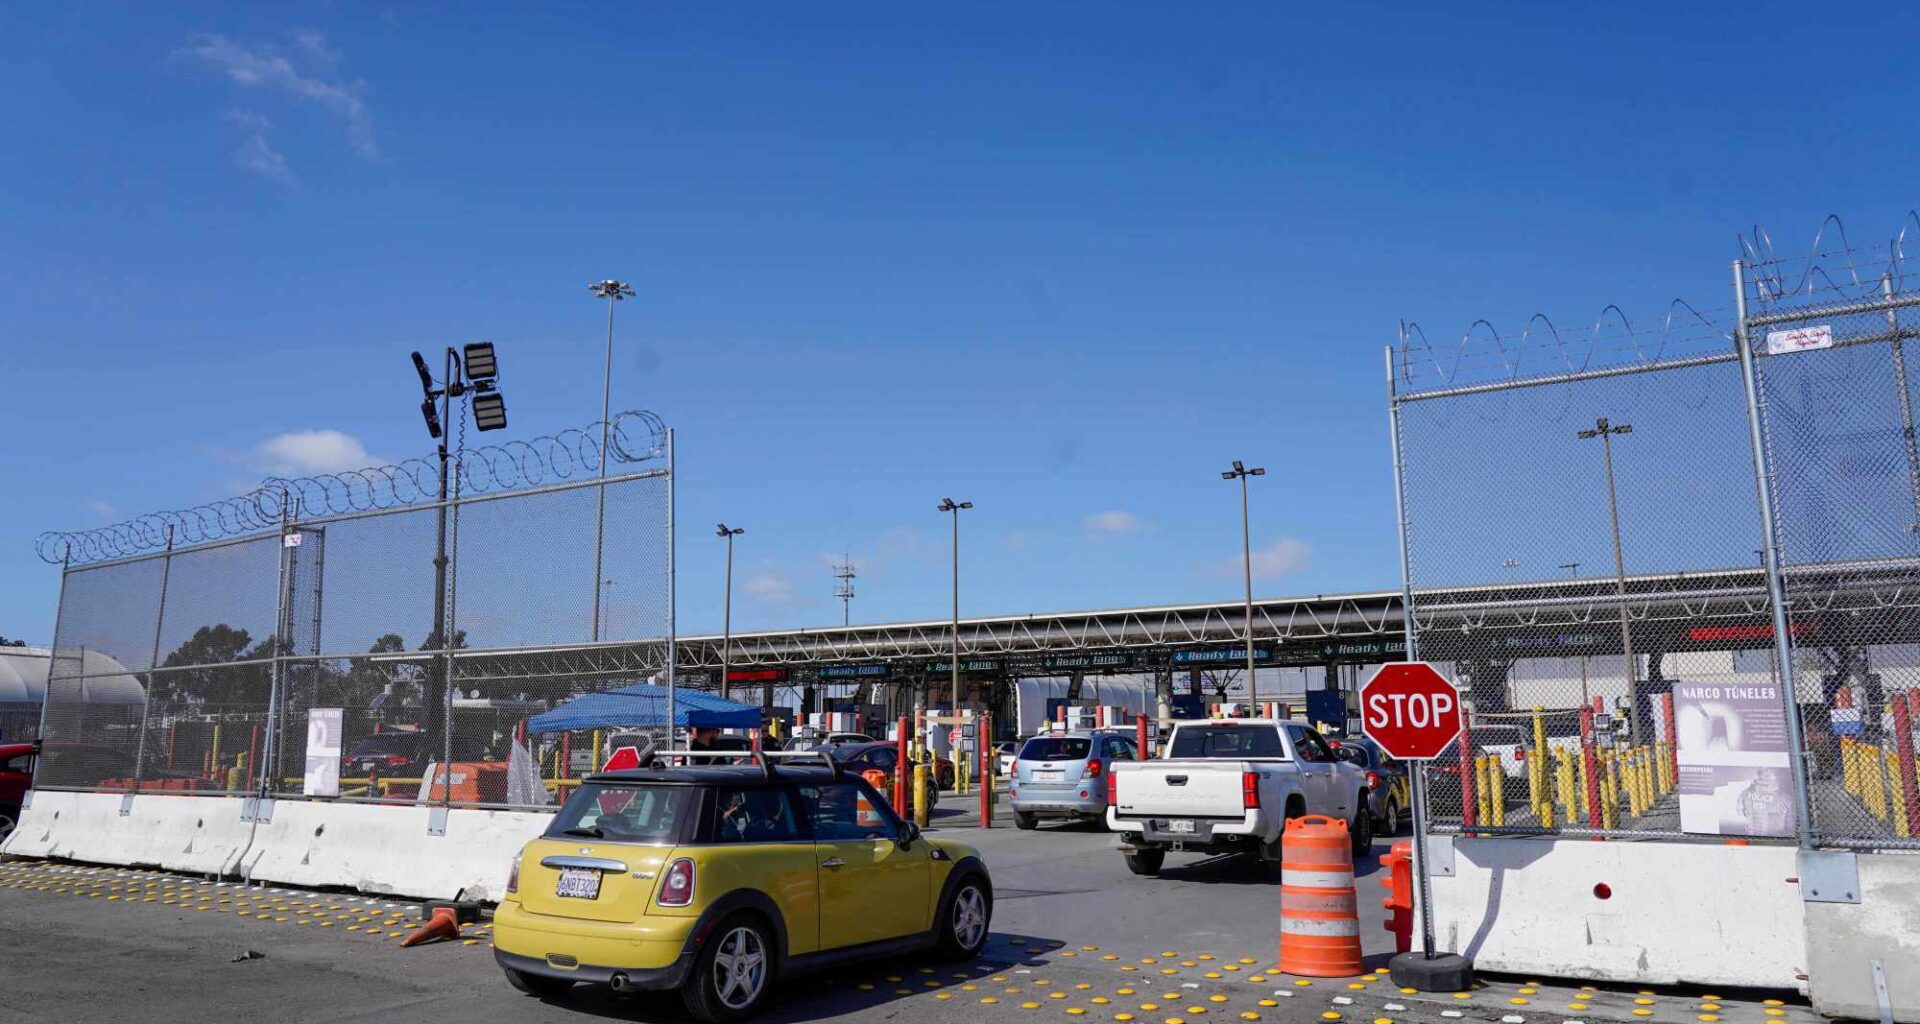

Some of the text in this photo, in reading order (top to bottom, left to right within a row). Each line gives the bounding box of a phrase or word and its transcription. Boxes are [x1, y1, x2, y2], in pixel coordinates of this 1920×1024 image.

[1339, 643, 1380, 654] Ready
[1188, 651, 1225, 660] Ready
[936, 662, 966, 672] Reay
[1057, 657, 1090, 667] Ready
[1682, 686, 1776, 699] NARCO TÚNELES
[1369, 693, 1452, 728] STOP
